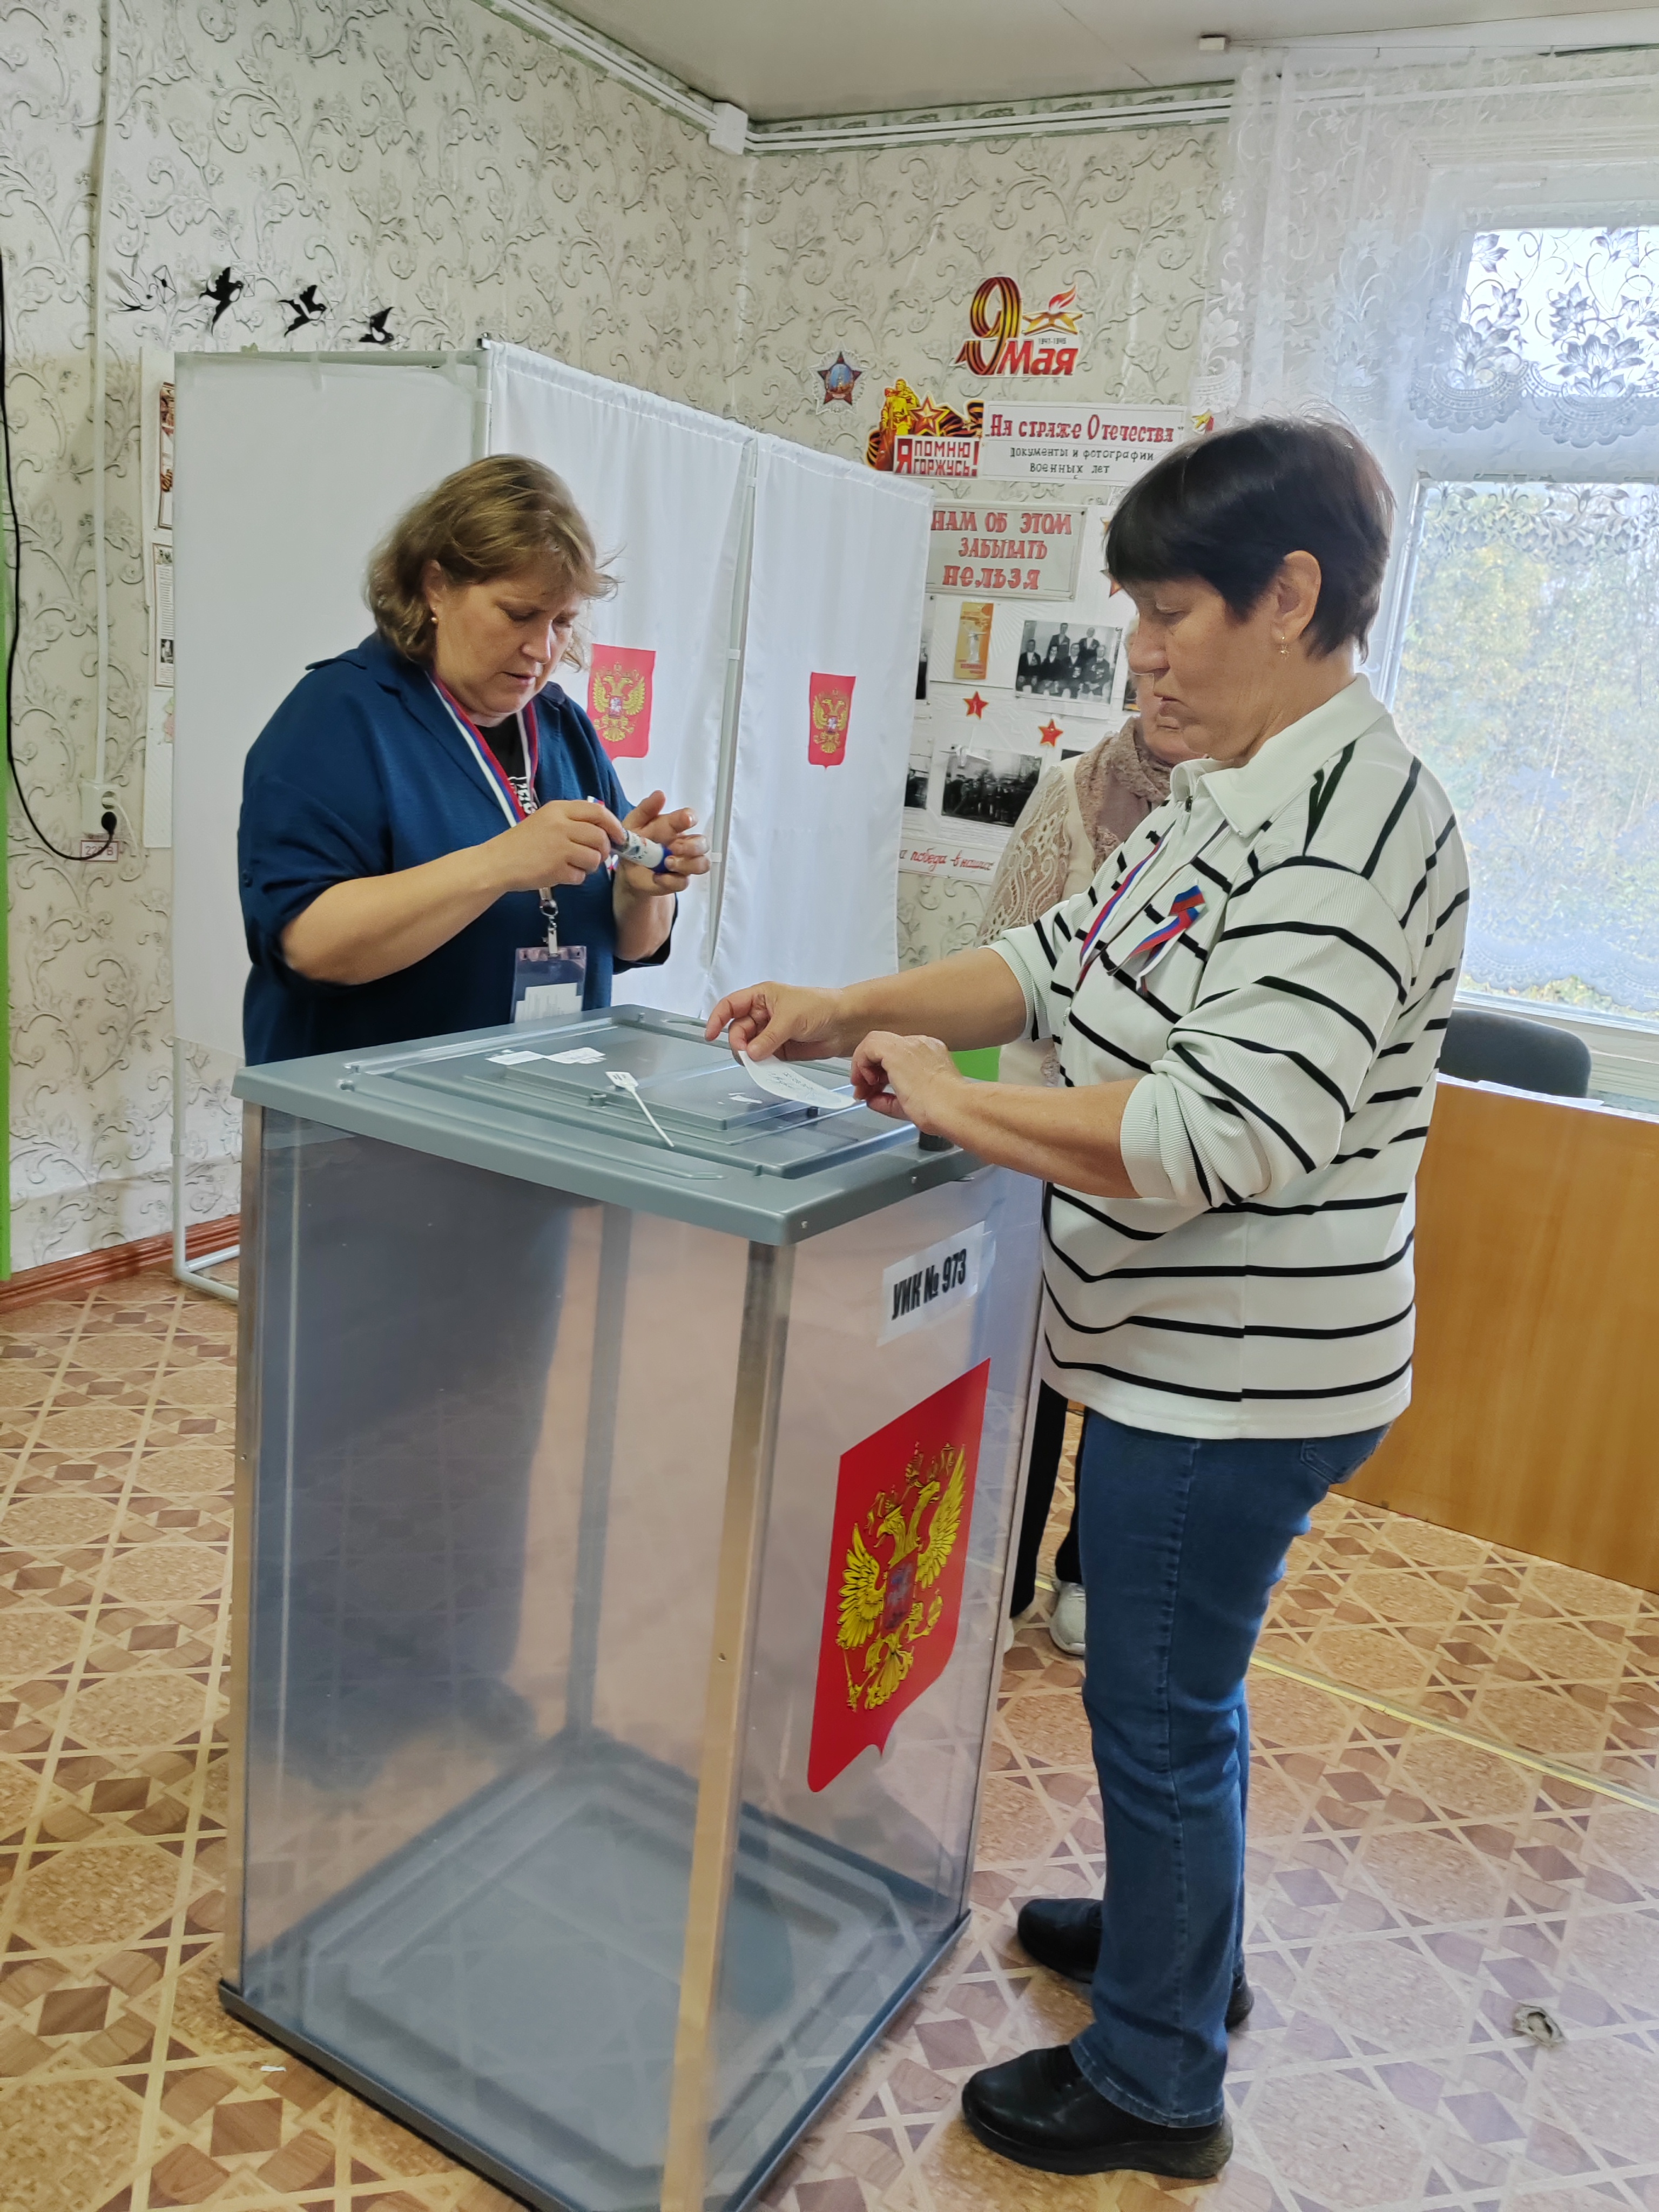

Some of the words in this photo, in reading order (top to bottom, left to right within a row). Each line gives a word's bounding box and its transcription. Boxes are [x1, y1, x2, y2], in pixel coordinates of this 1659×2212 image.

[955, 276, 1021, 375] 9
[996, 340, 1078, 375] Мая
[895, 439, 913, 474] Я
[915, 440, 970, 458] ПОМНЮ
[914, 458, 970, 476] ГОРЖУСЬ
[1073, 449, 1078, 457] и
[1083, 450, 1154, 462] фотографии
[1091, 465, 1110, 474] лет
[930, 510, 977, 531] НАМ
[985, 512, 1008, 532] ОБ
[1020, 512, 1072, 535] ЭТОМ
[958, 537, 1048, 559] ЗАБЫВАТЬ
[942, 1248, 967, 1293] 973
